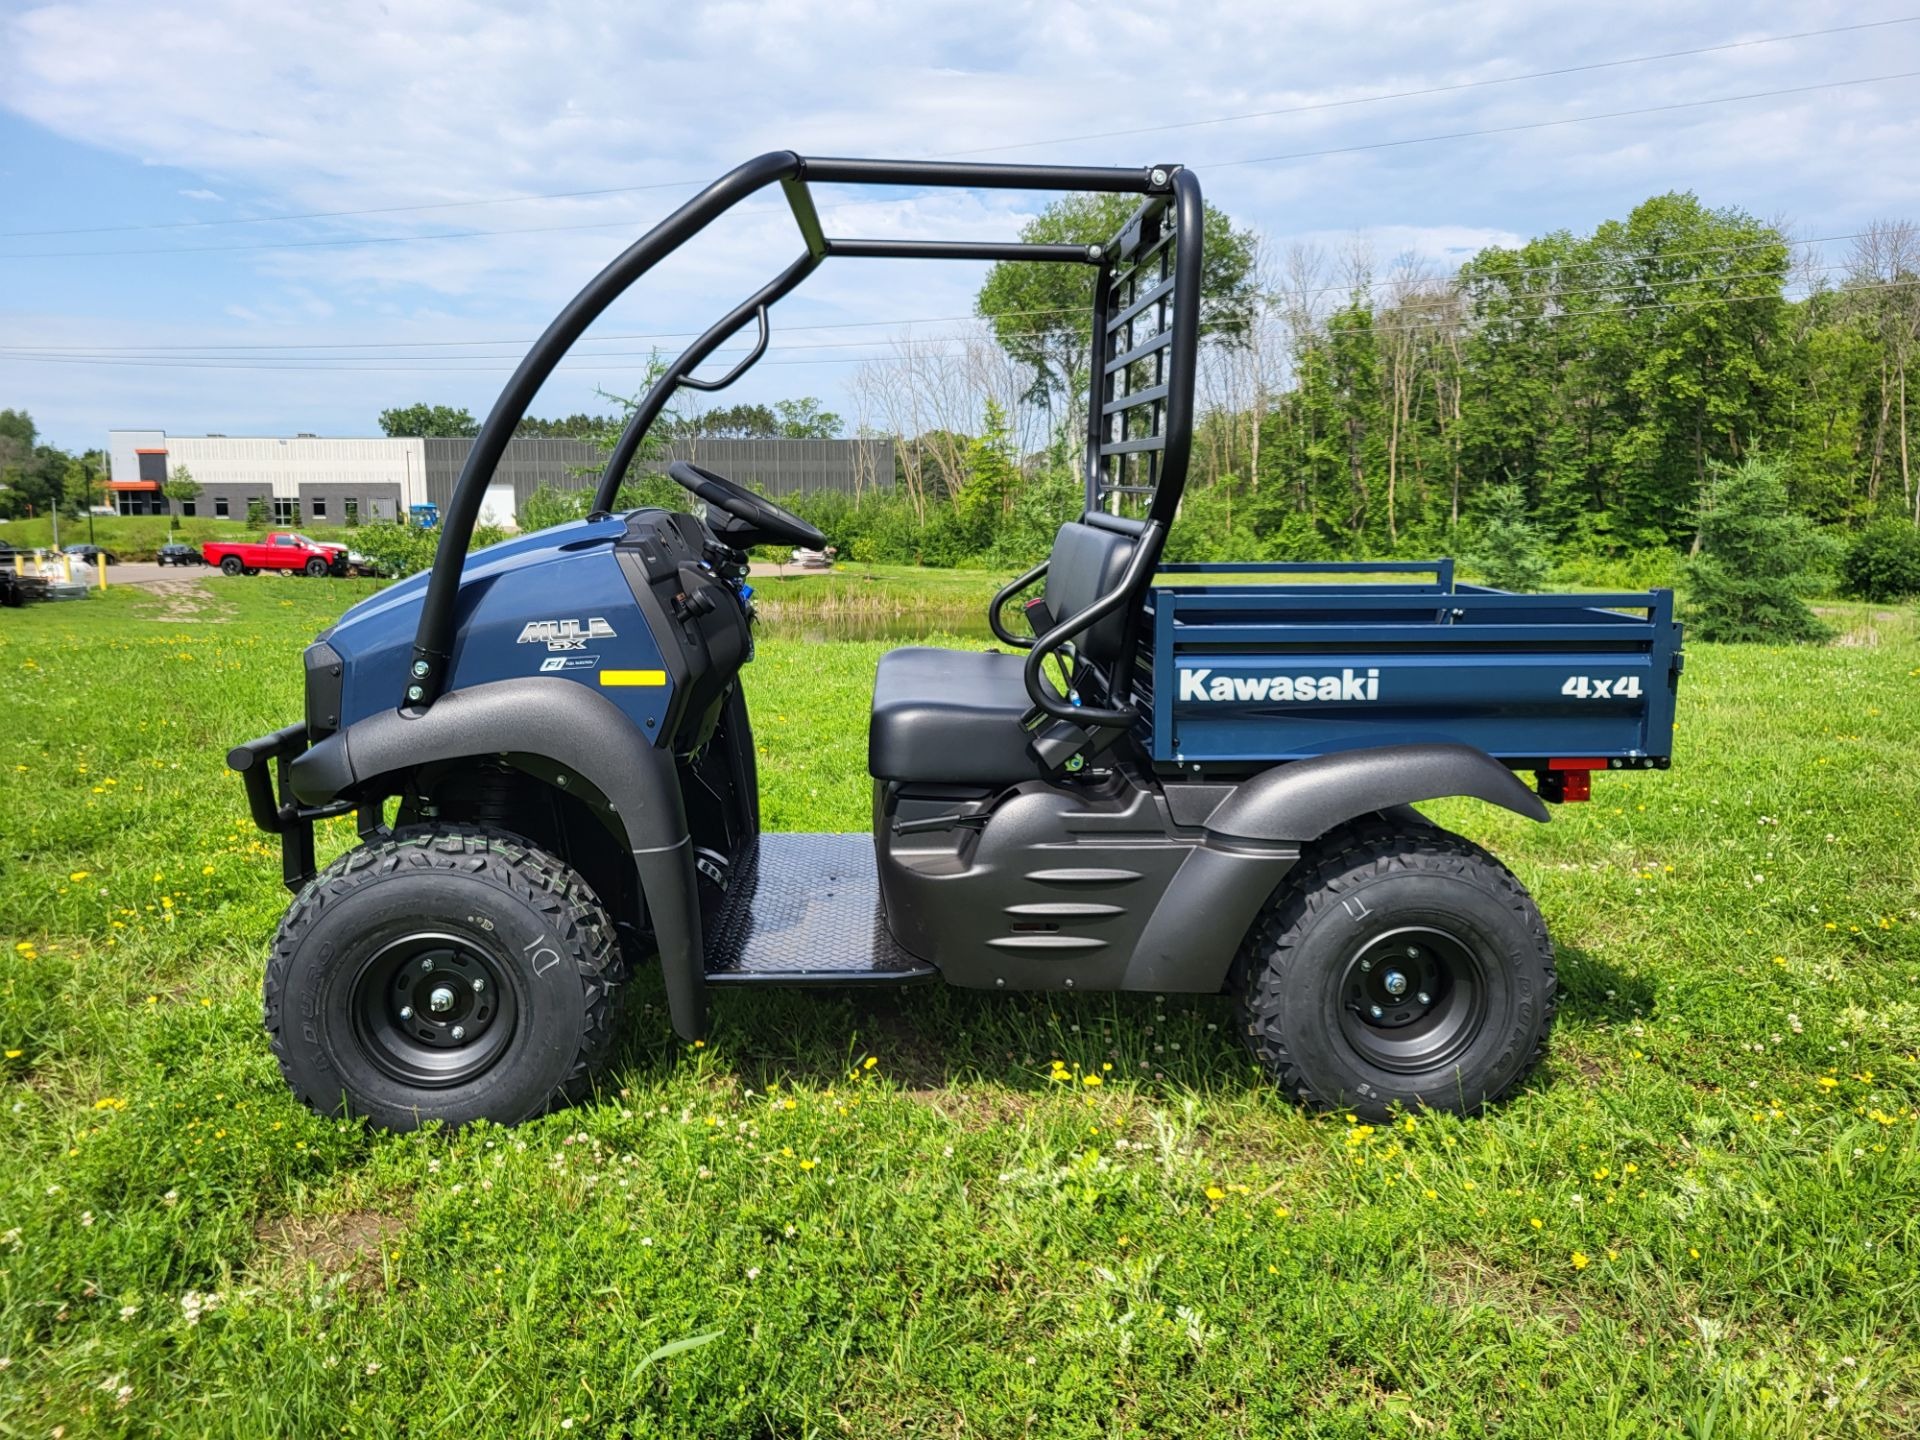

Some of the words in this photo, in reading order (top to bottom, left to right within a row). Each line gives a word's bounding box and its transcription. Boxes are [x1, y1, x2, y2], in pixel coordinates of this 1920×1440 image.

[517, 617, 617, 643] MULE
[548, 639, 587, 651] SX
[1179, 668, 1380, 701] Kawasaki
[1561, 676, 1643, 698] 4x4
[300, 940, 336, 1046] DURO
